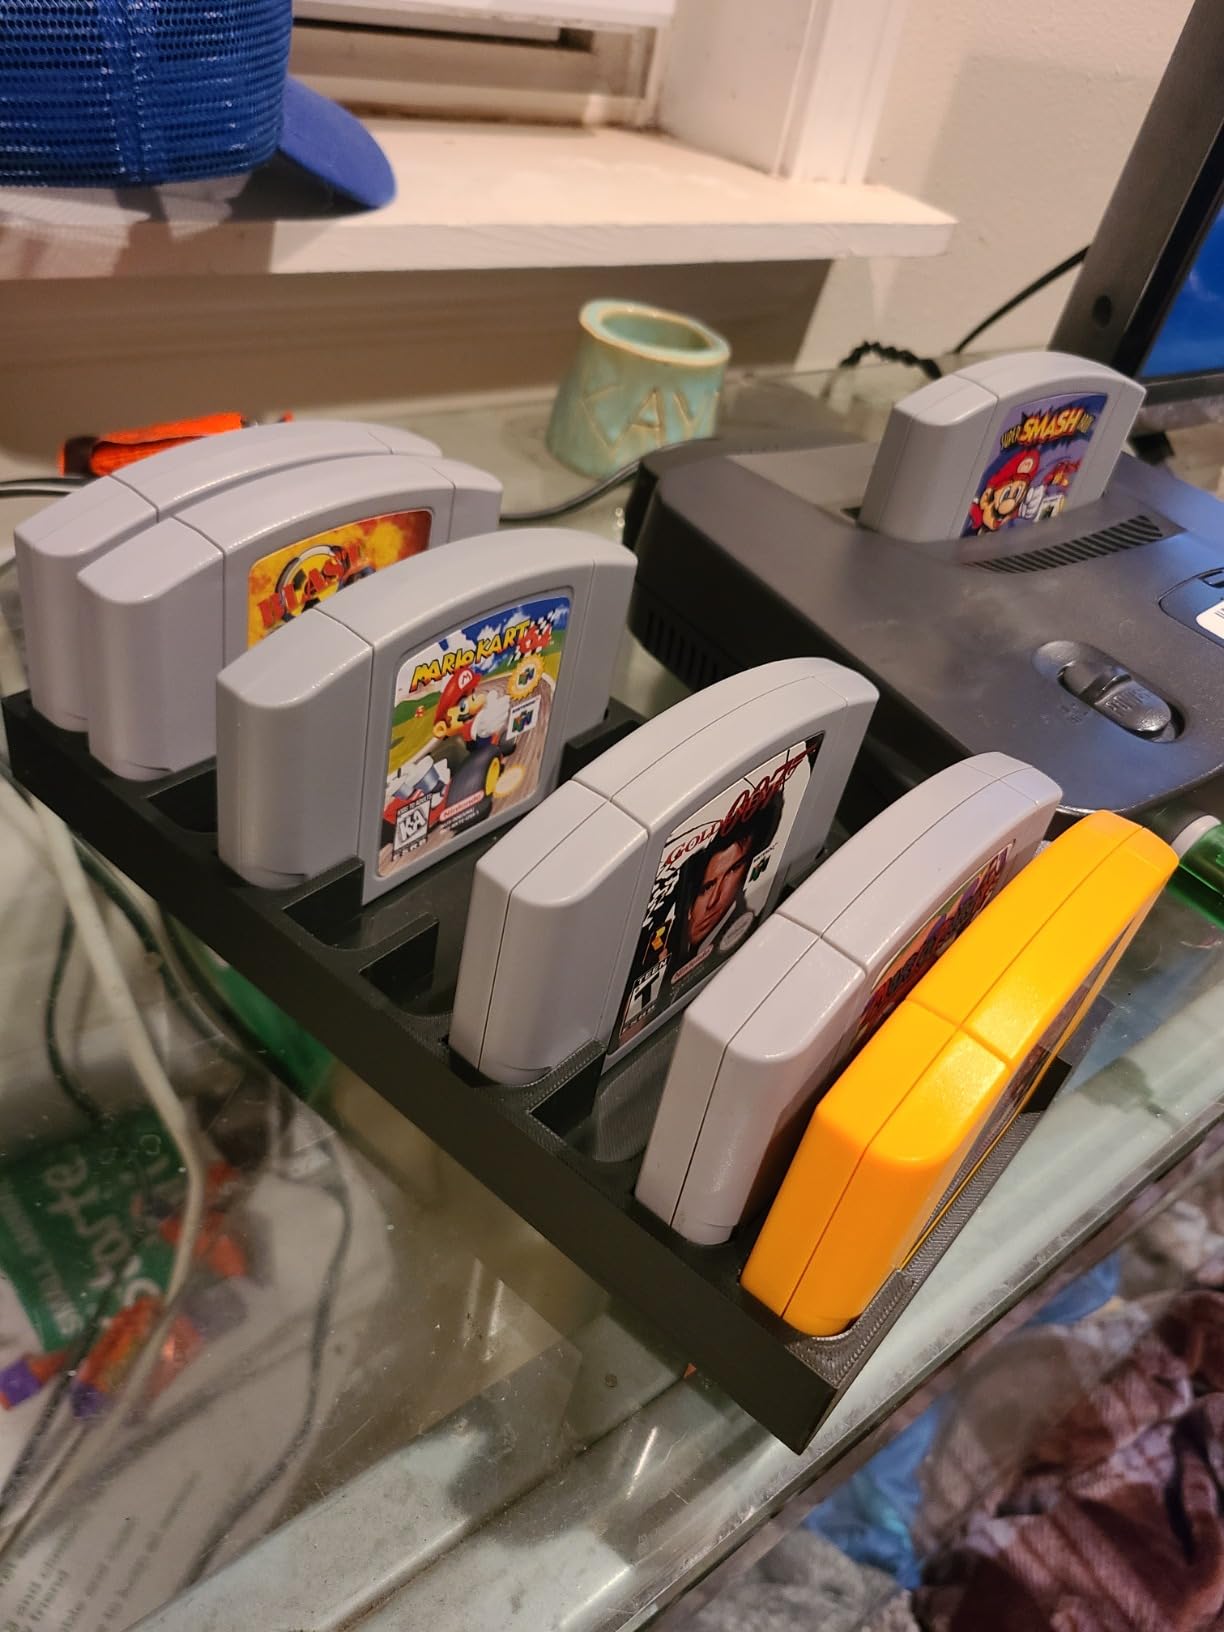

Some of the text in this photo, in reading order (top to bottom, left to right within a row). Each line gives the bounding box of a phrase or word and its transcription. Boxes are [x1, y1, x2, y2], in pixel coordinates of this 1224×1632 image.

[1019, 407, 1085, 444] SMASH
[409, 648, 475, 693] MARIO
[475, 619, 531, 664] KART
[634, 971, 660, 1009] T
[635, 958, 668, 985] TEEN
